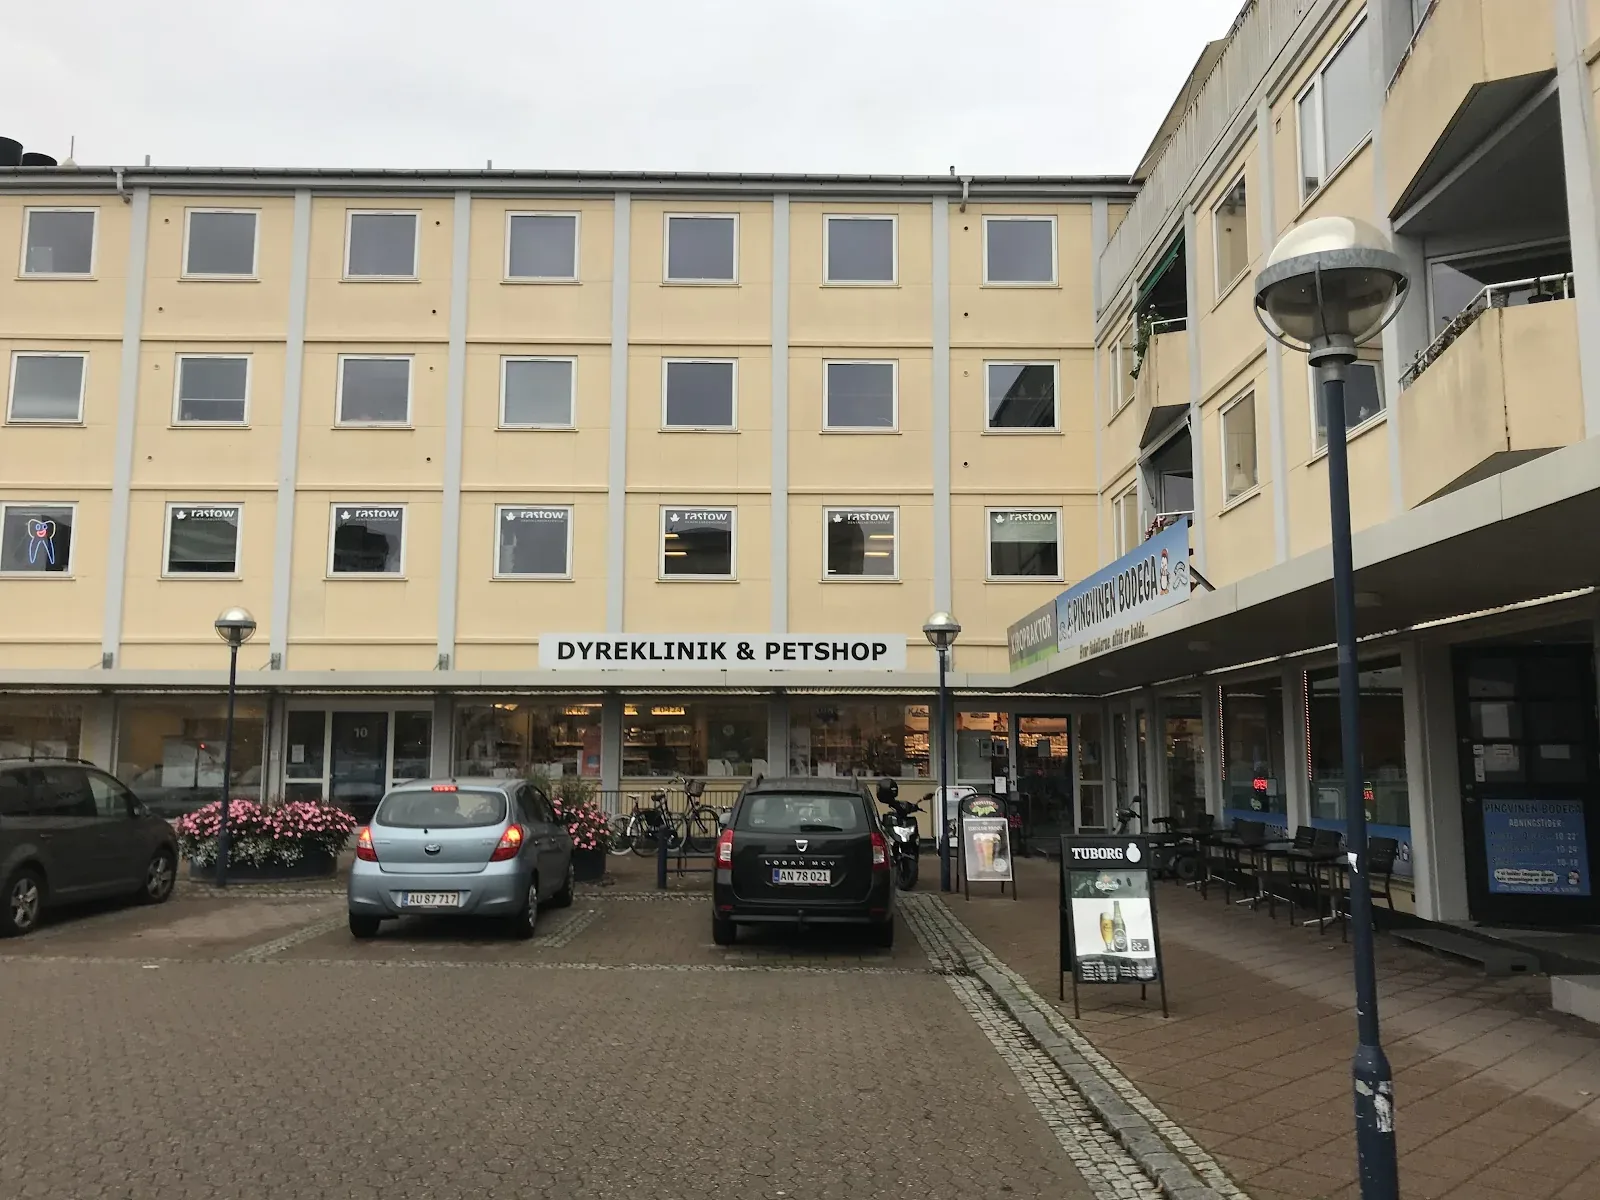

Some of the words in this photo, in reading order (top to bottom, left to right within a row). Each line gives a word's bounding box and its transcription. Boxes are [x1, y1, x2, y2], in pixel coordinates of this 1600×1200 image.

[190, 508, 235, 518] rastow
[355, 508, 399, 518] rastow
[520, 511, 564, 519] rastow
[684, 511, 728, 520] rastow
[847, 512, 890, 521] rastow
[1009, 512, 1053, 521] rastow
[1072, 576, 1117, 634] PINGVINEN
[1118, 554, 1158, 613] BODEGA
[1011, 613, 1052, 656] KIROPRAKTOR
[558, 641, 727, 661] DYREKLINIK
[736, 641, 756, 661] &
[765, 641, 887, 662] PETSHOP
[353, 726, 369, 739] 10
[1071, 847, 1124, 860] TUBORG
[780, 871, 794, 881] AN
[796, 871, 809, 881] 78
[810, 872, 828, 882] 021
[409, 893, 423, 904] AU
[424, 893, 438, 904] 87
[438, 893, 458, 904] 717
